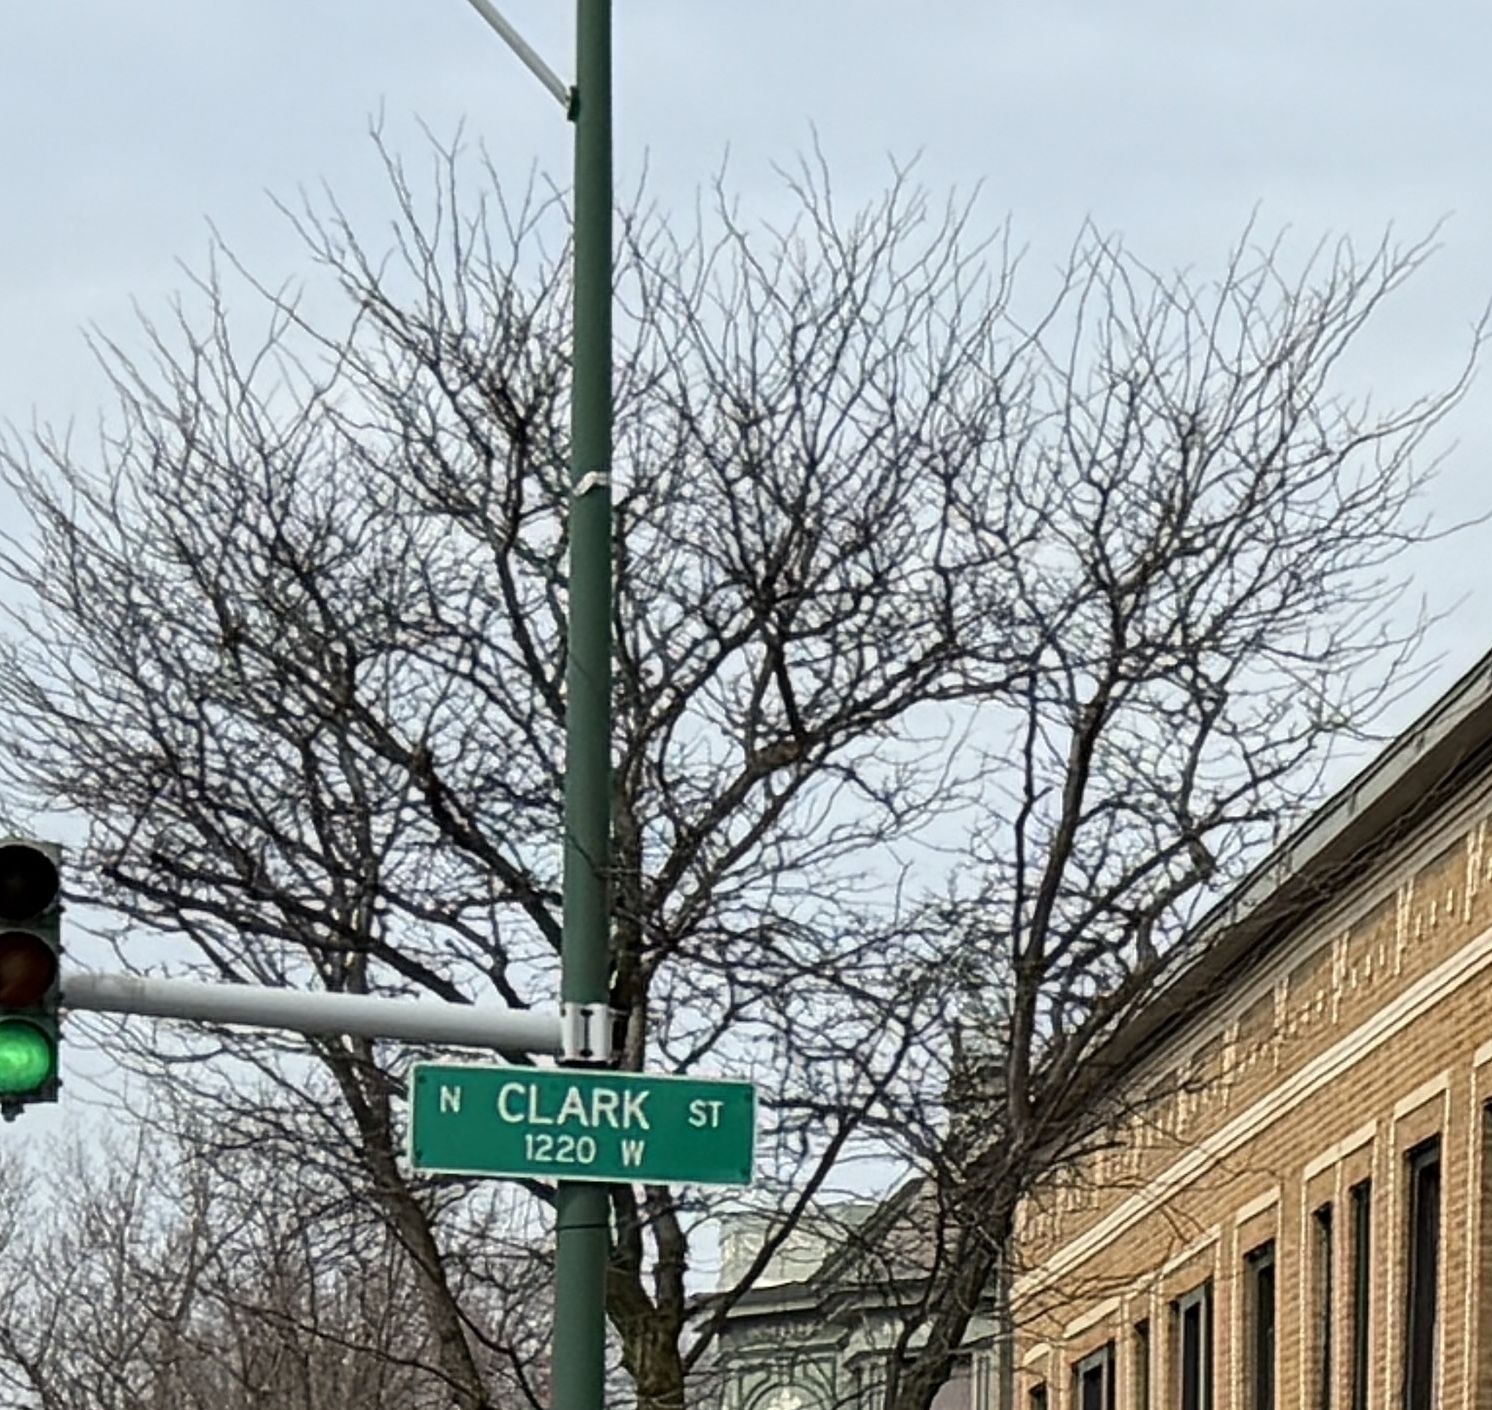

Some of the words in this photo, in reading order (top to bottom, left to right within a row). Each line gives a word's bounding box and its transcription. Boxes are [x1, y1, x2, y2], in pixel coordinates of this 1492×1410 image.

[440, 1085, 461, 1113] N
[498, 1082, 650, 1130] CLARK
[688, 1100, 723, 1128] ST
[525, 1133, 596, 1163] 1220
[622, 1140, 645, 1167] W
